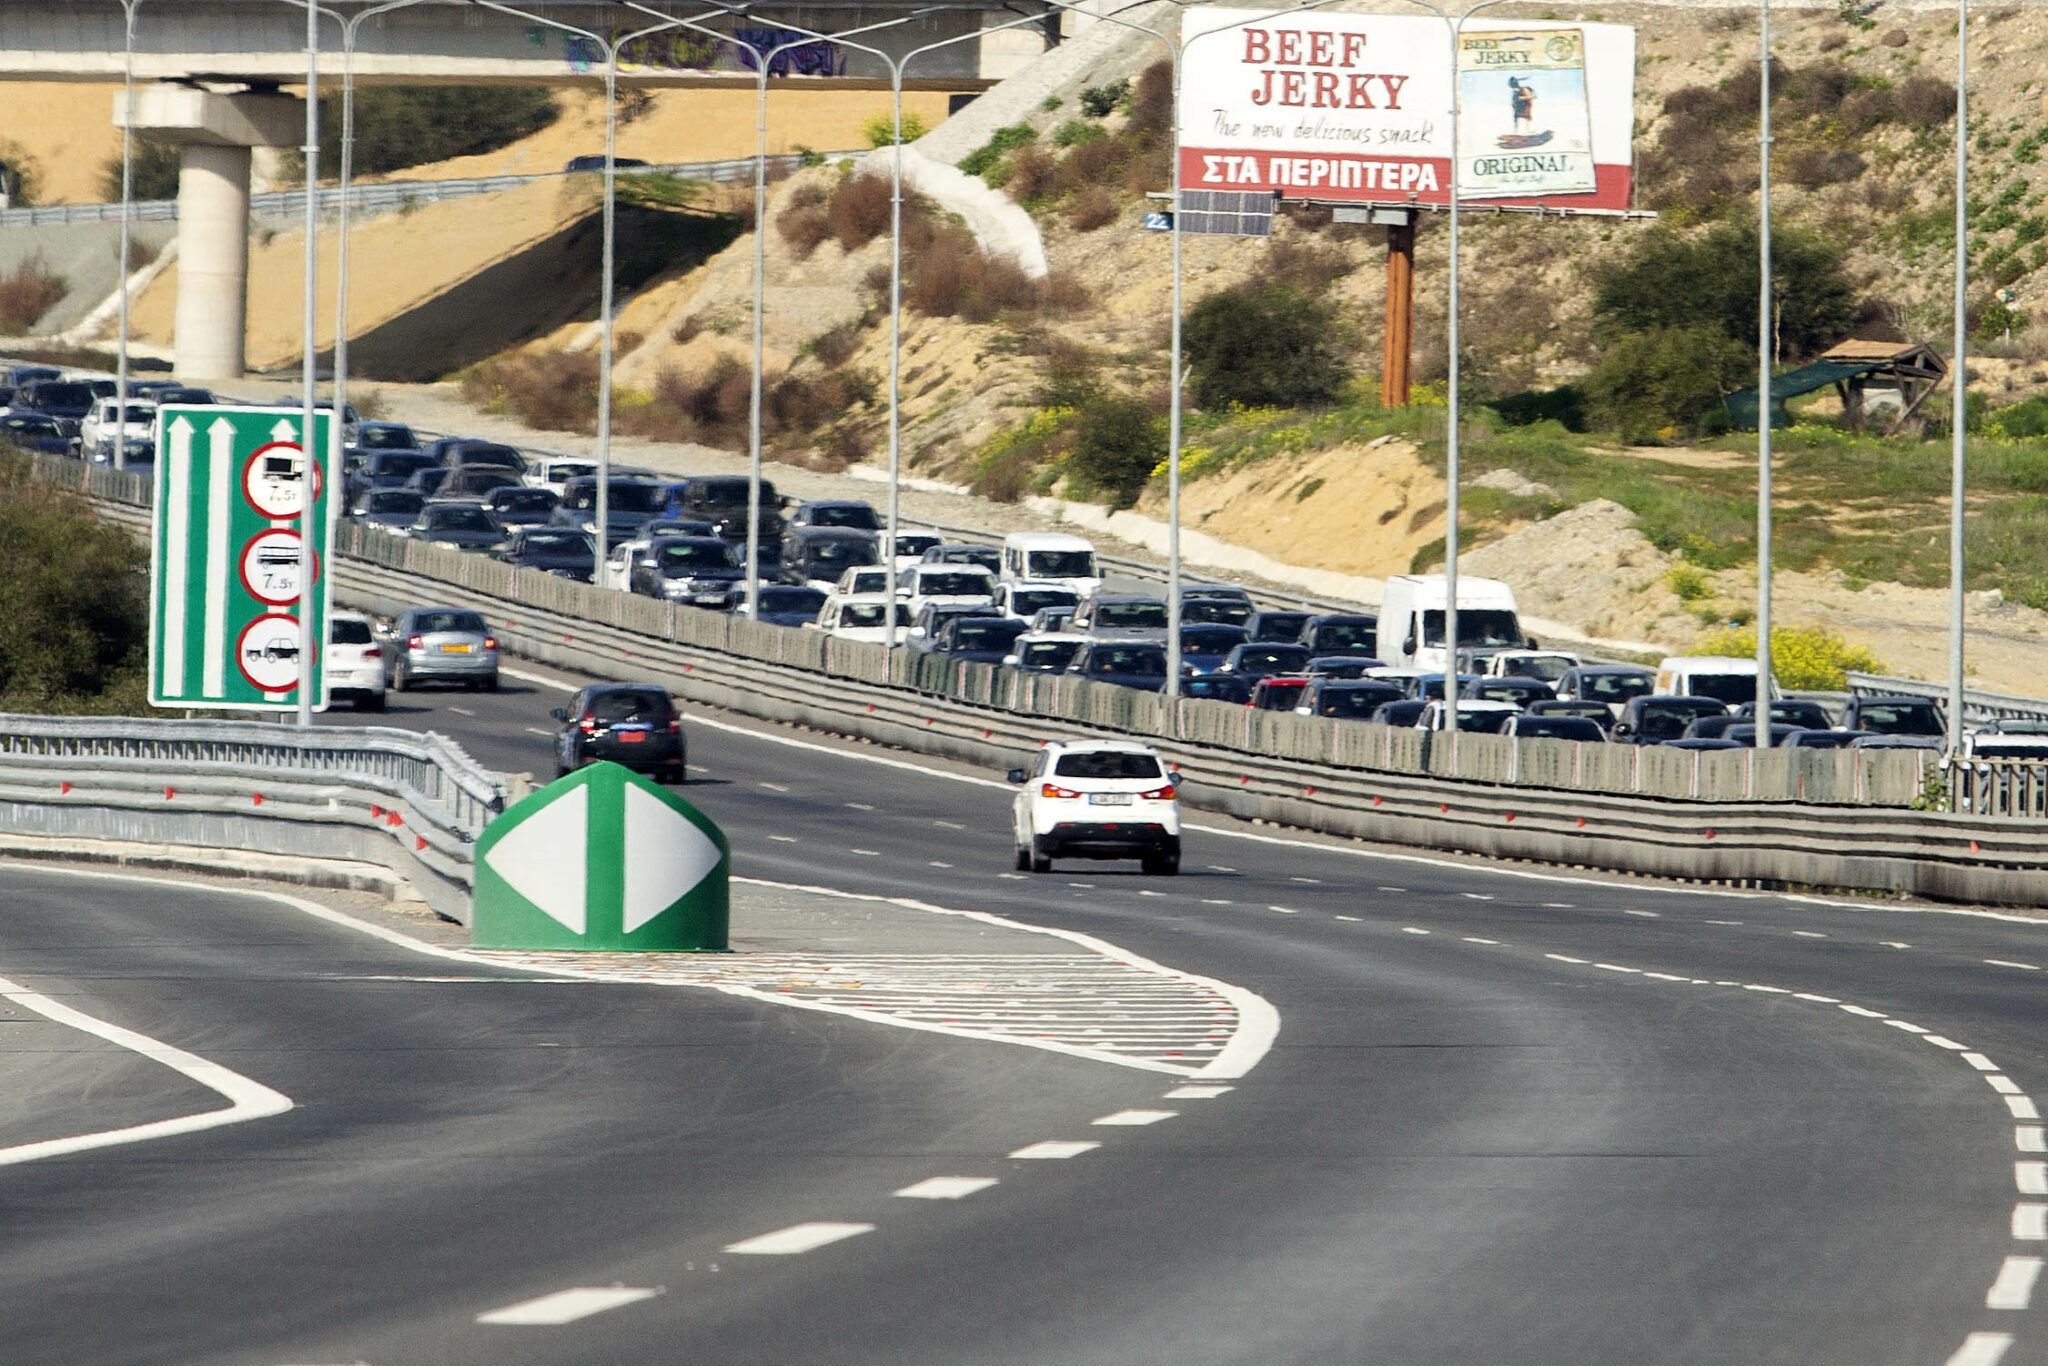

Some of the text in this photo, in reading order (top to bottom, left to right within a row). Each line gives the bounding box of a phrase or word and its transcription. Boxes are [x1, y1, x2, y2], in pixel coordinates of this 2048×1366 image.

[1241, 28, 1366, 67] BEEF
[1463, 39, 1500, 50] BEEF
[1475, 51, 1531, 64] JERKY
[1252, 70, 1409, 109] JERKY
[1213, 109, 1240, 137] The
[1252, 122, 1283, 138] new
[1294, 116, 1371, 143] delicious
[1202, 155, 1439, 191] ΣΤΑ ΠΕΡΙΠΤΕΡΑ
[1473, 155, 1574, 176] ORIGINAL
